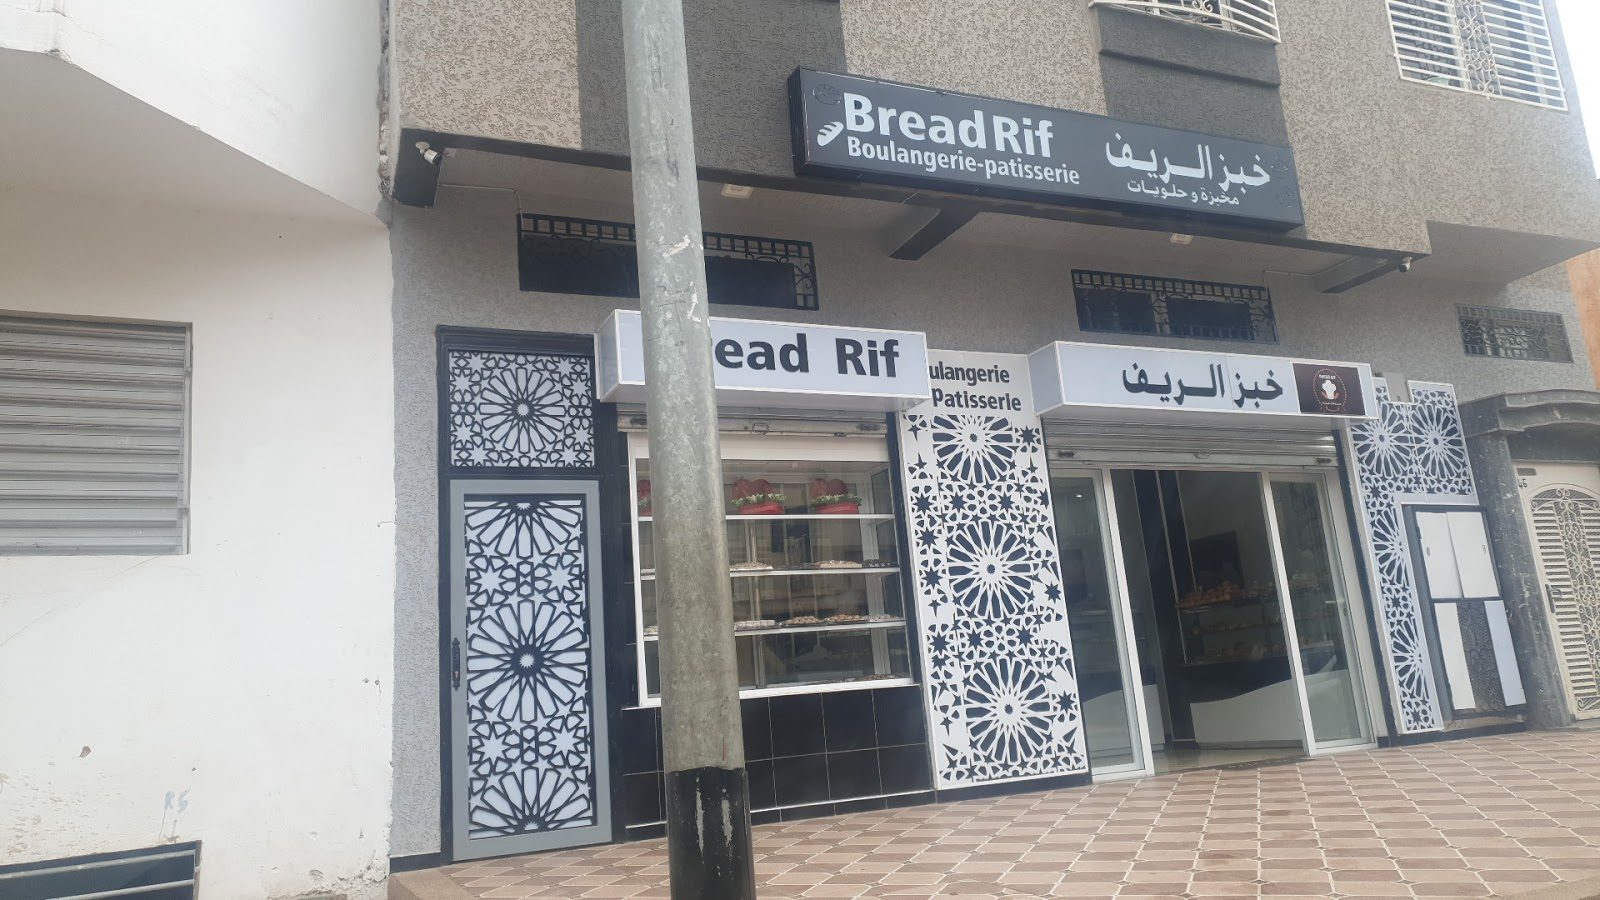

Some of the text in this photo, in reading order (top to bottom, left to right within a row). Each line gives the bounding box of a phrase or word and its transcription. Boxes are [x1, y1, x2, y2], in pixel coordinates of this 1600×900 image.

[843, 92, 1054, 158] Bread Rif
[847, 135, 1080, 185] Boulangerie-patisserie
[1105, 132, 1271, 194] خبز الريف
[1127, 179, 1240, 206] مخبزة و حلويات
[711, 333, 900, 378] ead Rif
[930, 361, 1010, 387] ulangerie
[931, 387, 1022, 412] Patisserie
[1122, 362, 1284, 409] خبز الريف
